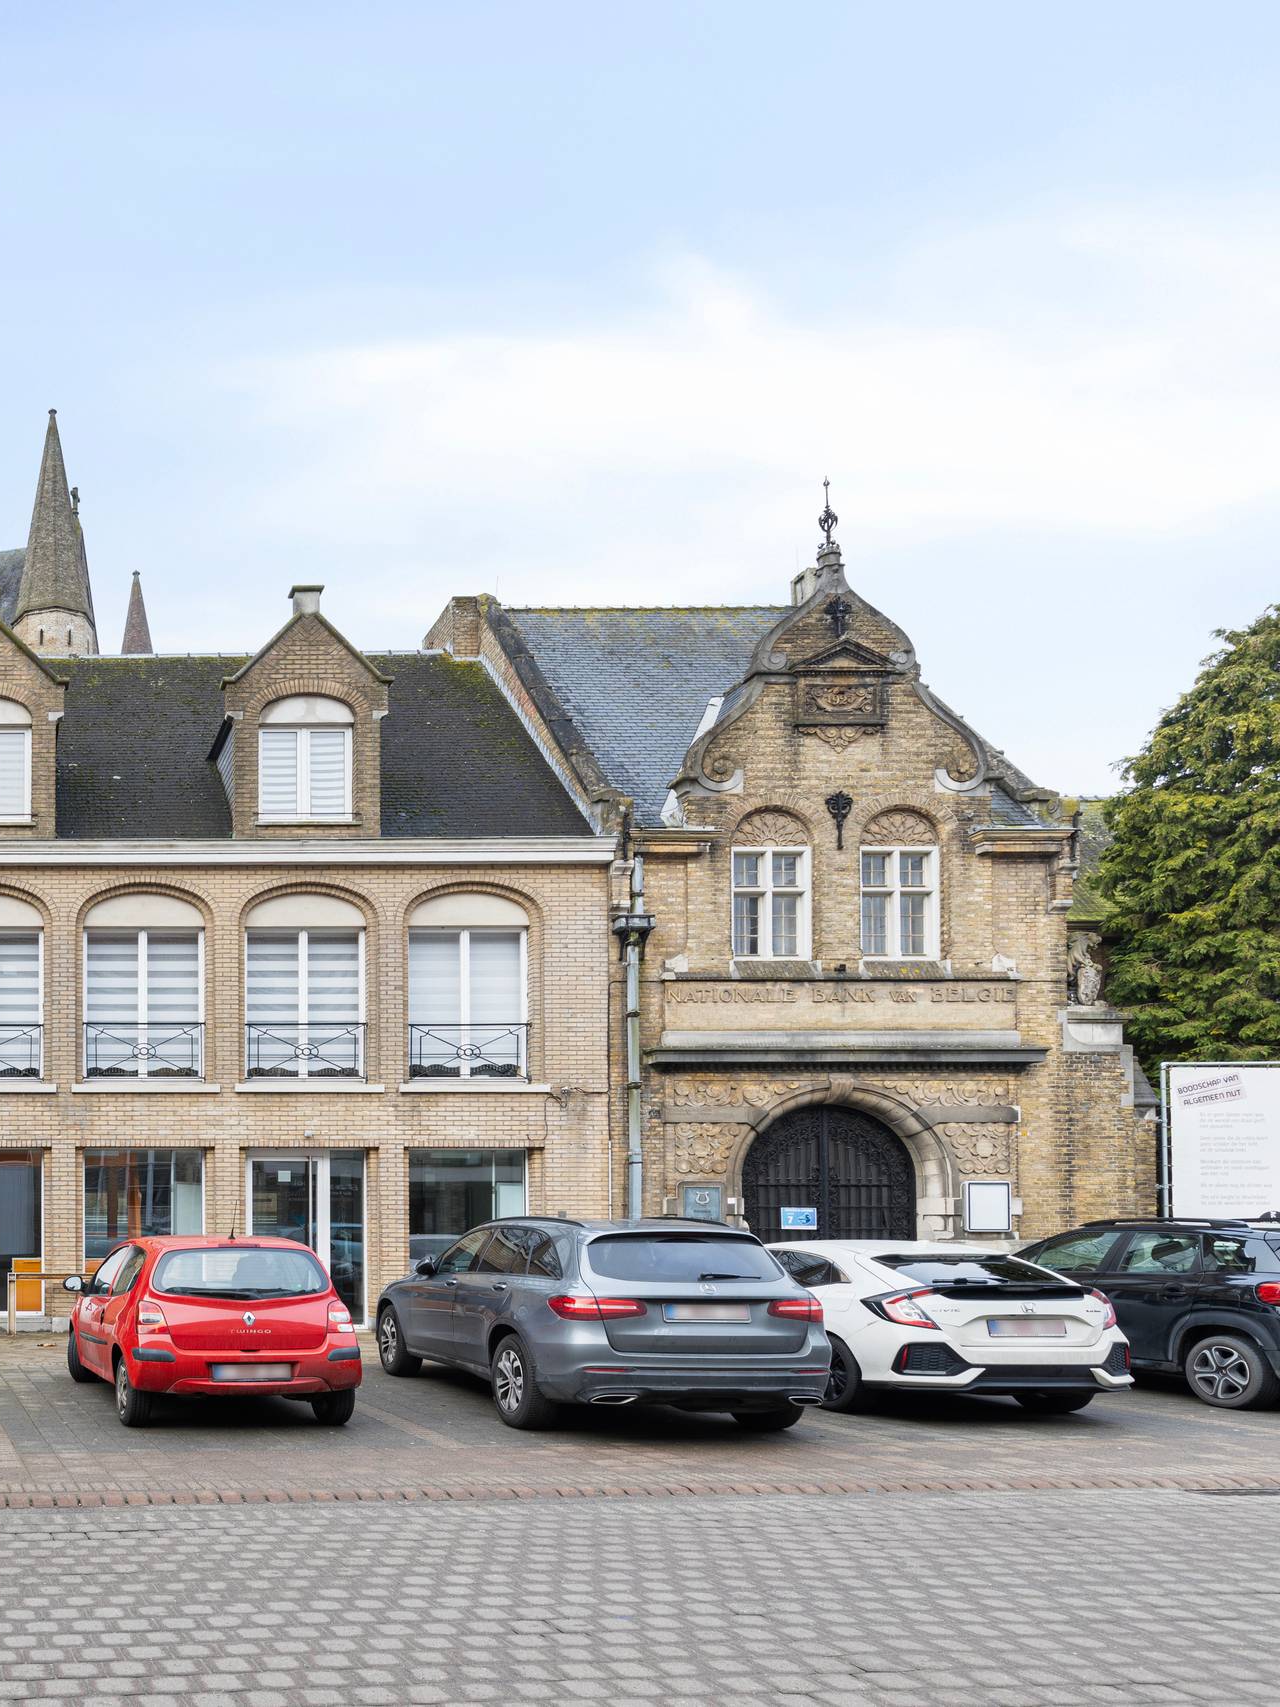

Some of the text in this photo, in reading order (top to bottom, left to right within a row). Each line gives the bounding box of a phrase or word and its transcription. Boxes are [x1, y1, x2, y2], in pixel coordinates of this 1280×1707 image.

[666, 988, 797, 1003] NATIONALE
[811, 988, 876, 1003] BANK
[930, 988, 1017, 1003] BELGIE
[1177, 1074, 1239, 1095] BOODSCHAP VAN
[1183, 1089, 1241, 1106] ALGEMEEN NUT
